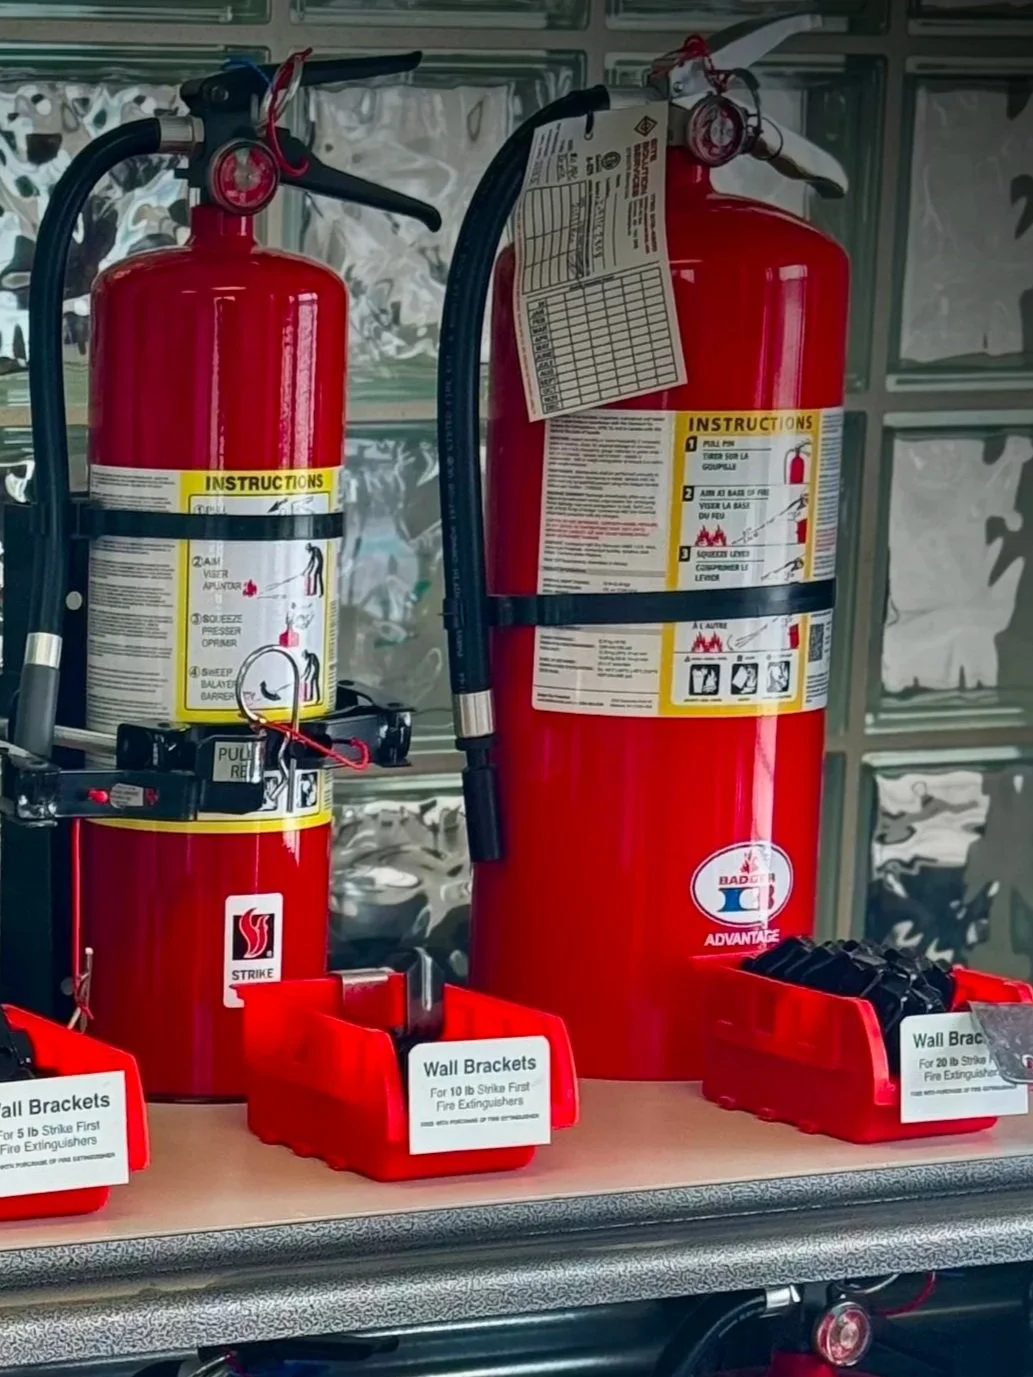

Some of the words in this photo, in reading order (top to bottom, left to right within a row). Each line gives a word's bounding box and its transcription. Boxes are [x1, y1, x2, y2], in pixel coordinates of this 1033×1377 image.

[688, 416, 813, 432] INSTRUCTIONS
[205, 473, 324, 492] INSTRUCTIONS
[202, 569, 229, 580] VISER
[202, 580, 243, 592] APUNTAR
[202, 614, 243, 625] SQUEEZE
[201, 626, 242, 636] PRESSER
[201, 667, 234, 678] SWEEP
[231, 967, 275, 981] STRIKE
[913, 1032, 944, 1048] Wall
[949, 1031, 984, 1046] Brac
[424, 1060, 458, 1077] Wall
[464, 1055, 537, 1075] Brackets
[919, 1058, 934, 1069] For
[936, 1057, 948, 1067] 20
[949, 1056, 959, 1067] lb
[961, 1056, 987, 1066] Strike
[924, 1071, 942, 1082] Fire
[944, 1069, 998, 1082] Extinguisher
[430, 1087, 447, 1098] For
[450, 1086, 462, 1097] 10
[465, 1085, 475, 1096] lb
[477, 1082, 506, 1095] Strike
[508, 1081, 530, 1092] First
[29, 1093, 111, 1115] Brackets
[436, 1101, 456, 1112] Fire
[458, 1096, 524, 1111] Extinguishers
[17, 1128, 25, 1139] 5
[28, 1127, 39, 1138] lb
[41, 1123, 74, 1136] Strike
[76, 1120, 101, 1133] First
[0, 1143, 21, 1155] Fire
[24, 1135, 98, 1153] Extinguishers
